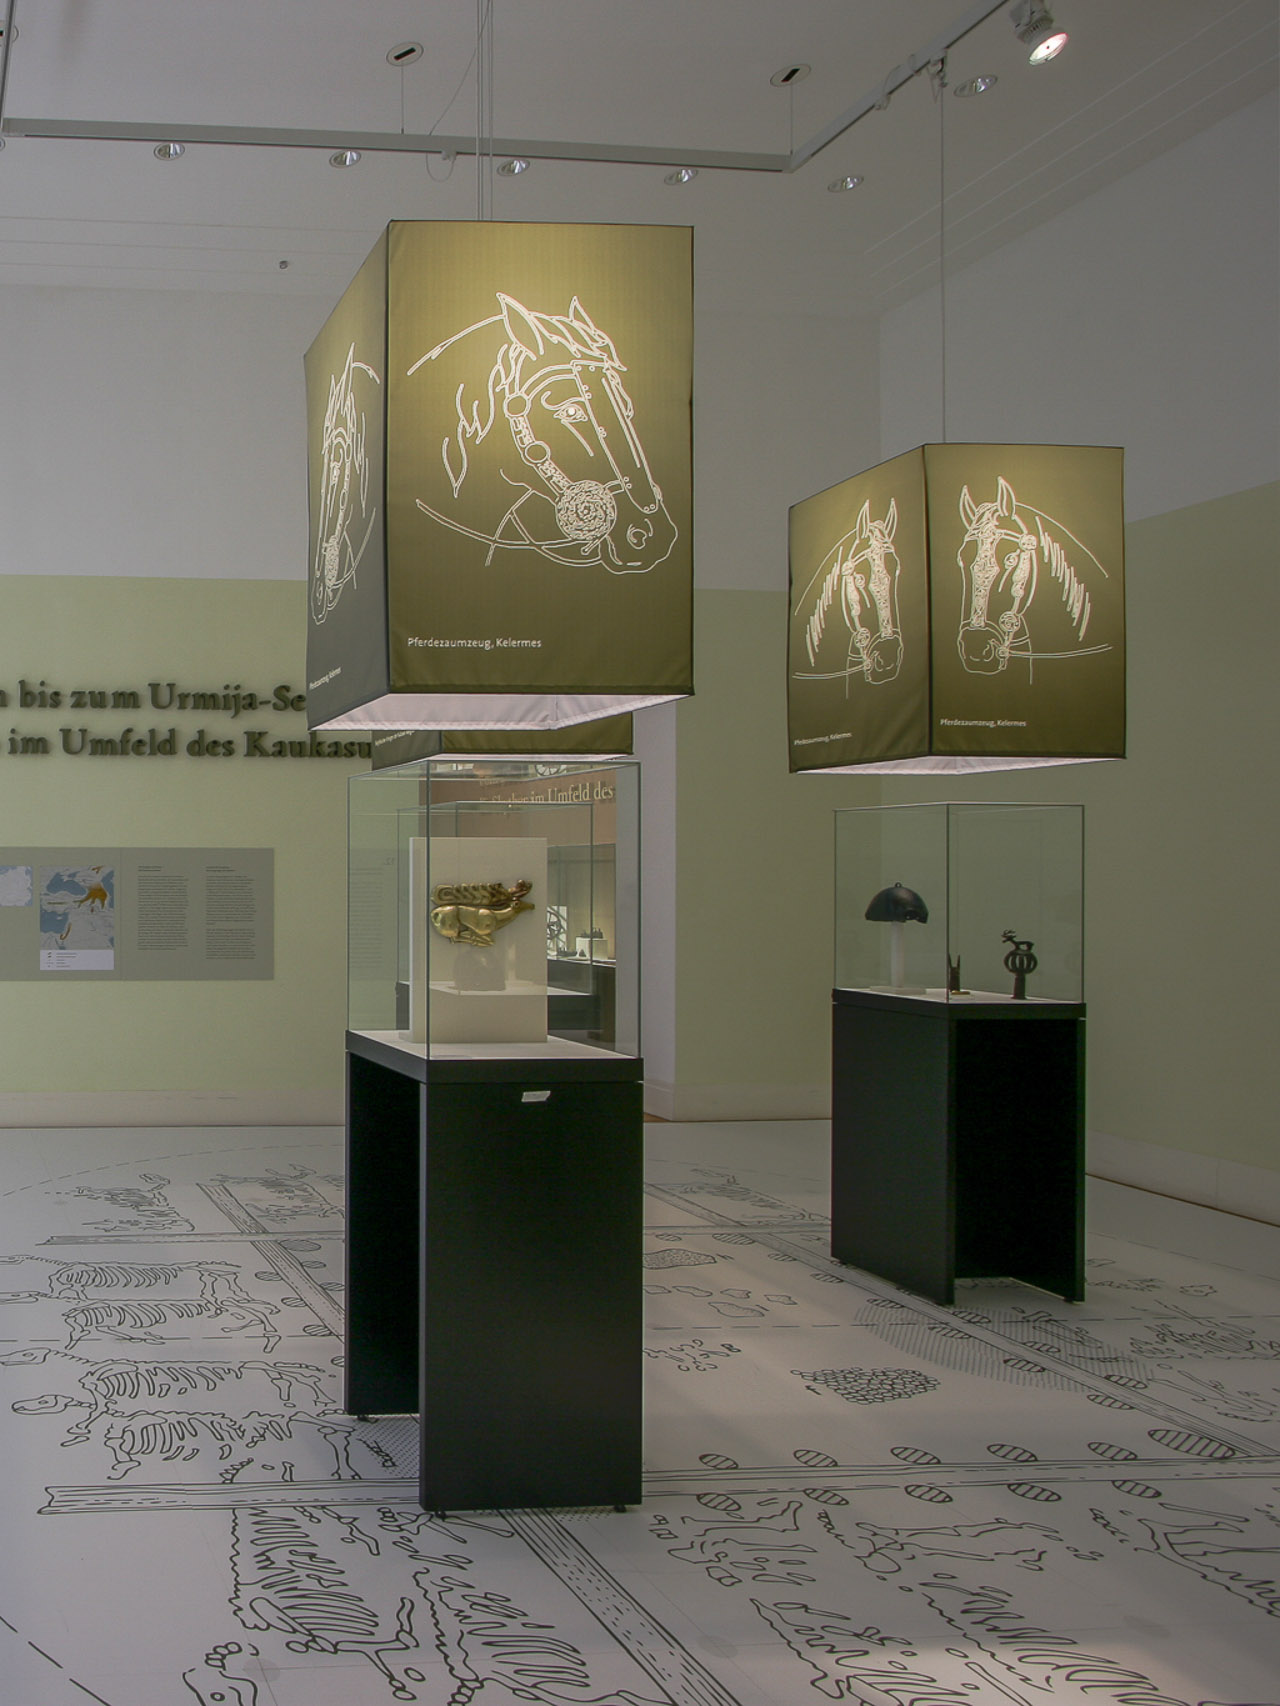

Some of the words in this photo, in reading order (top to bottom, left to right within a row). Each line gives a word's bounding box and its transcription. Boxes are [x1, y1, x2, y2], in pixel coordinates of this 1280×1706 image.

[407, 637, 494, 650] Pferdezaumzeug,
[496, 638, 542, 648] Kelermes
[18, 680, 62, 708] bis
[70, 690, 141, 709] zum
[148, 683, 306, 719] Urmija-Se
[8, 728, 50, 755] im
[59, 728, 178, 756] Umfeld
[186, 729, 236, 757] des
[243, 730, 372, 758] Kaukasu
[593, 781, 615, 801] des
